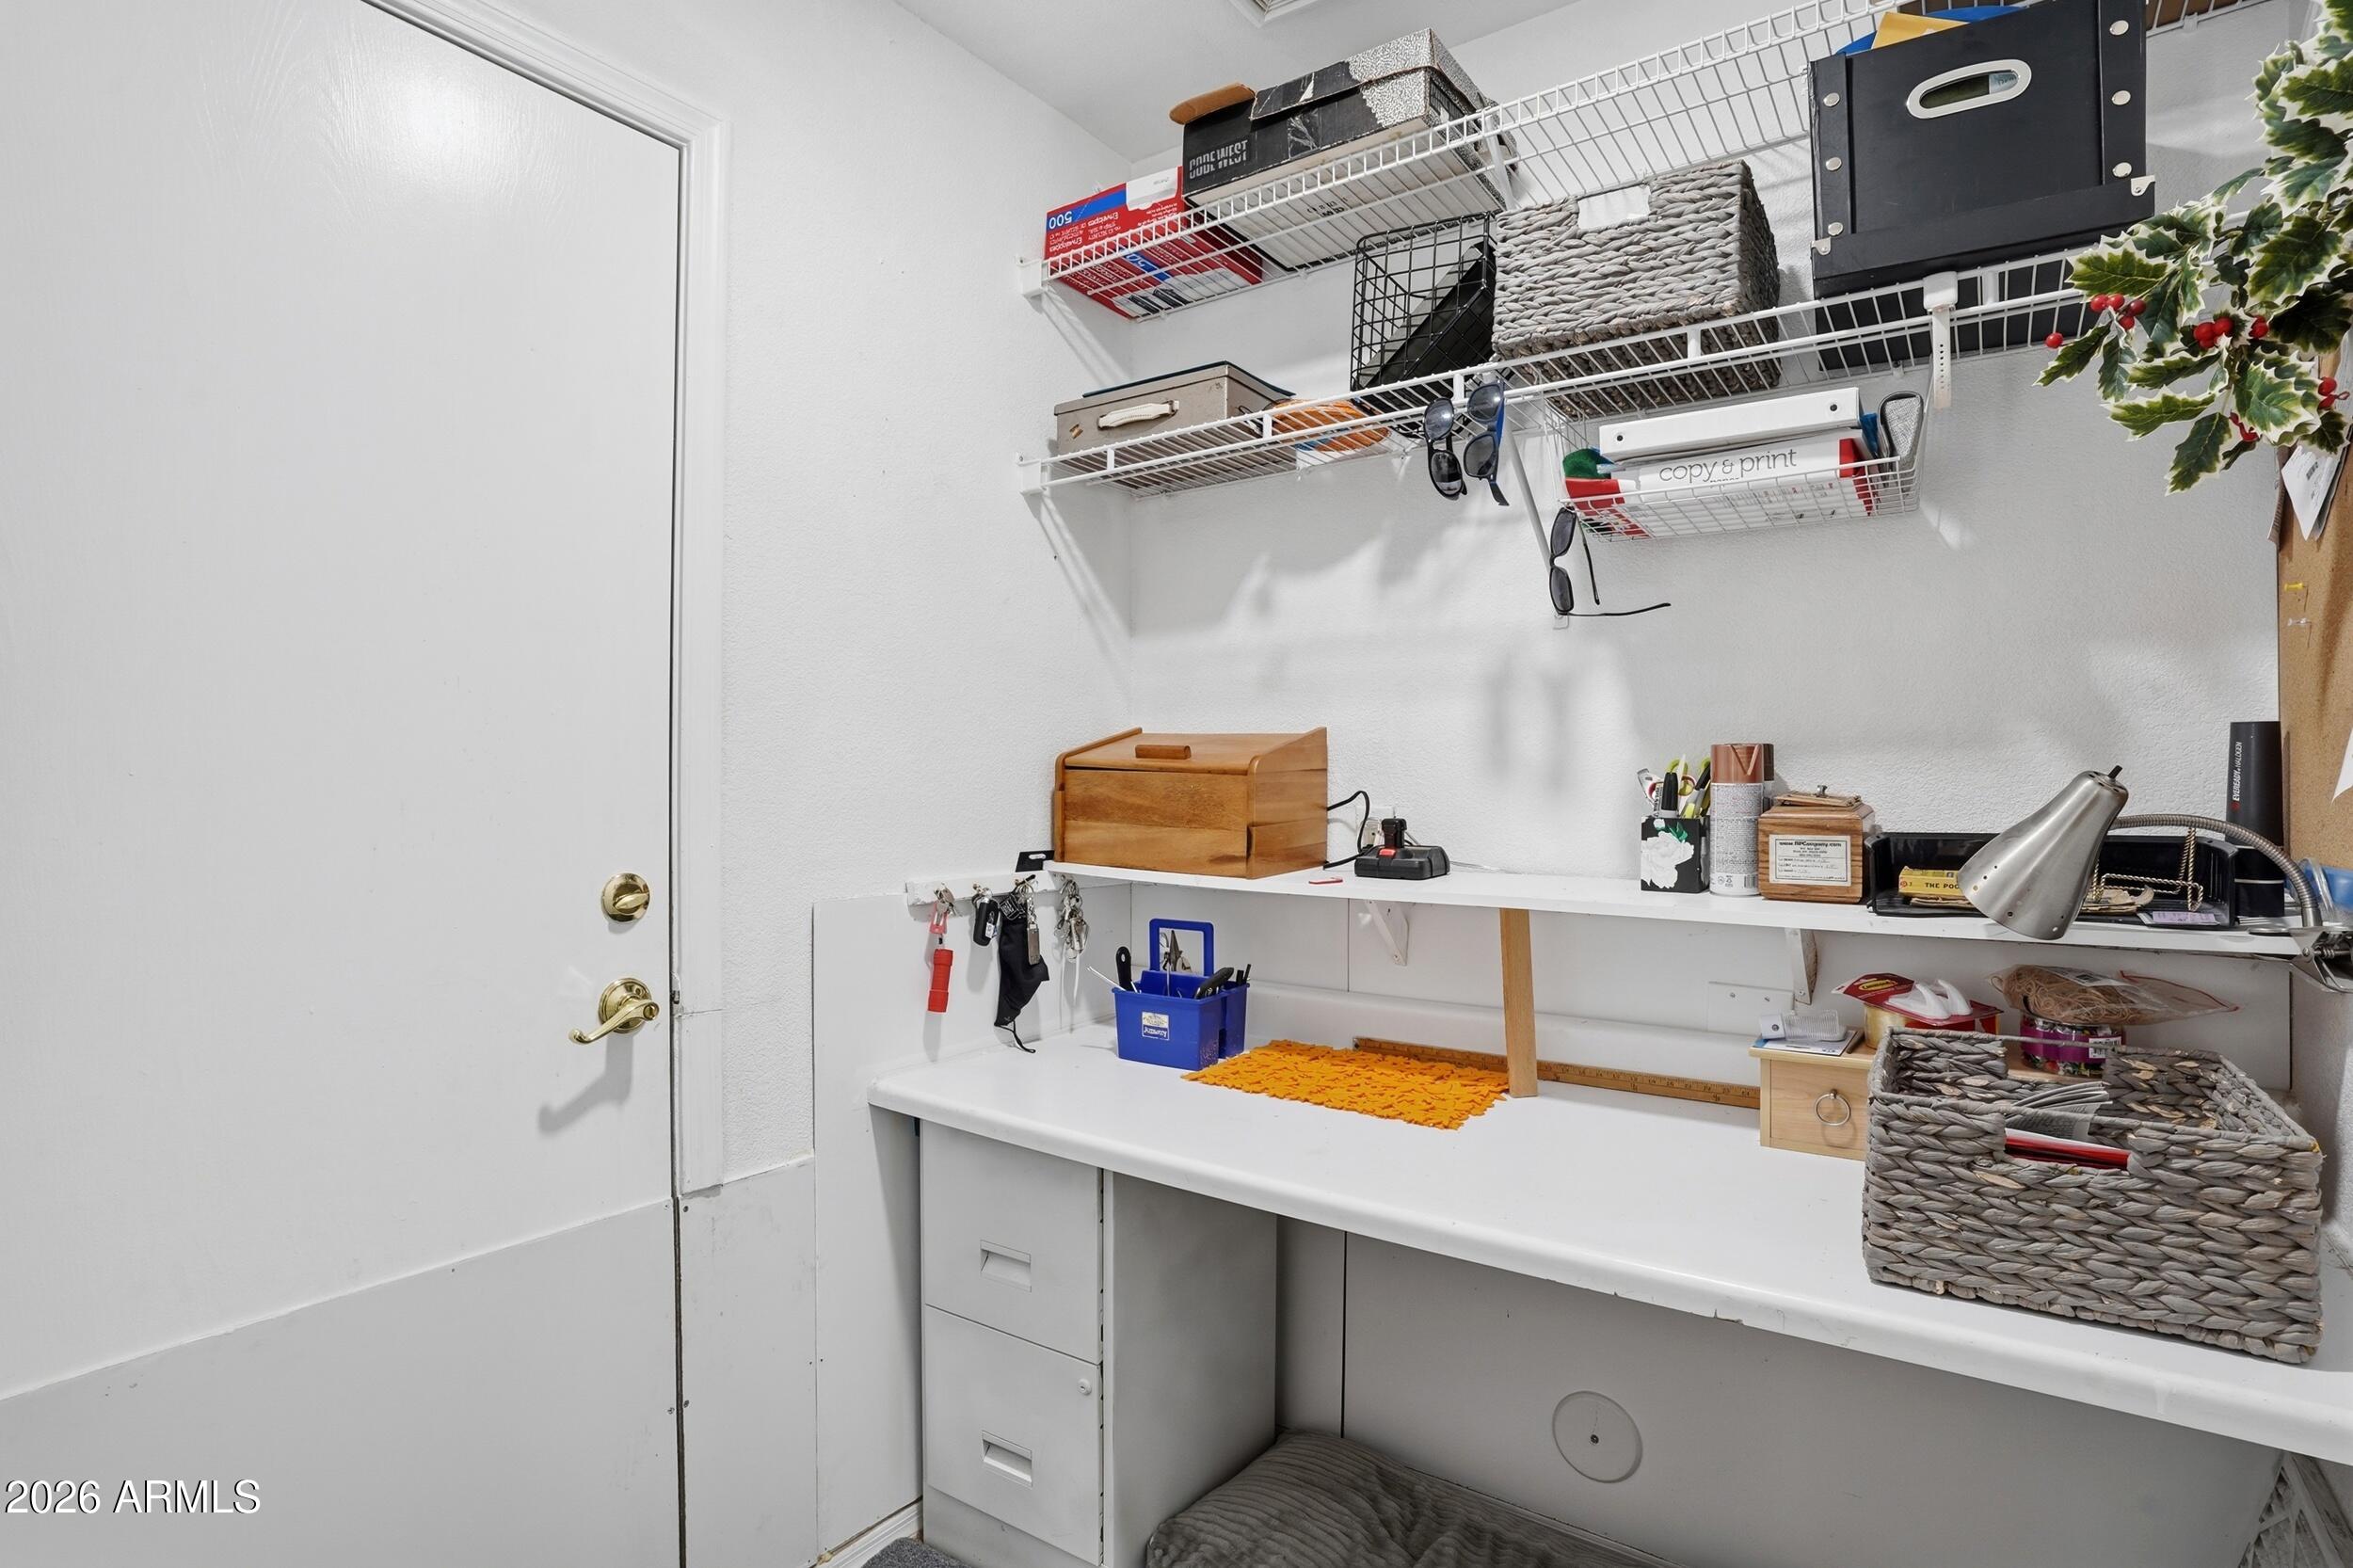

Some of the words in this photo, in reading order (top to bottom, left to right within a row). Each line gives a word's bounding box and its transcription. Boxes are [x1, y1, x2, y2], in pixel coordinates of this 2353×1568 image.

[1189, 151, 1216, 180] CODE
[1217, 139, 1248, 169] WEST
[1048, 211, 1072, 230] 500
[1659, 460, 1718, 484] copy
[1721, 459, 1735, 475] &
[1738, 449, 1798, 478] print
